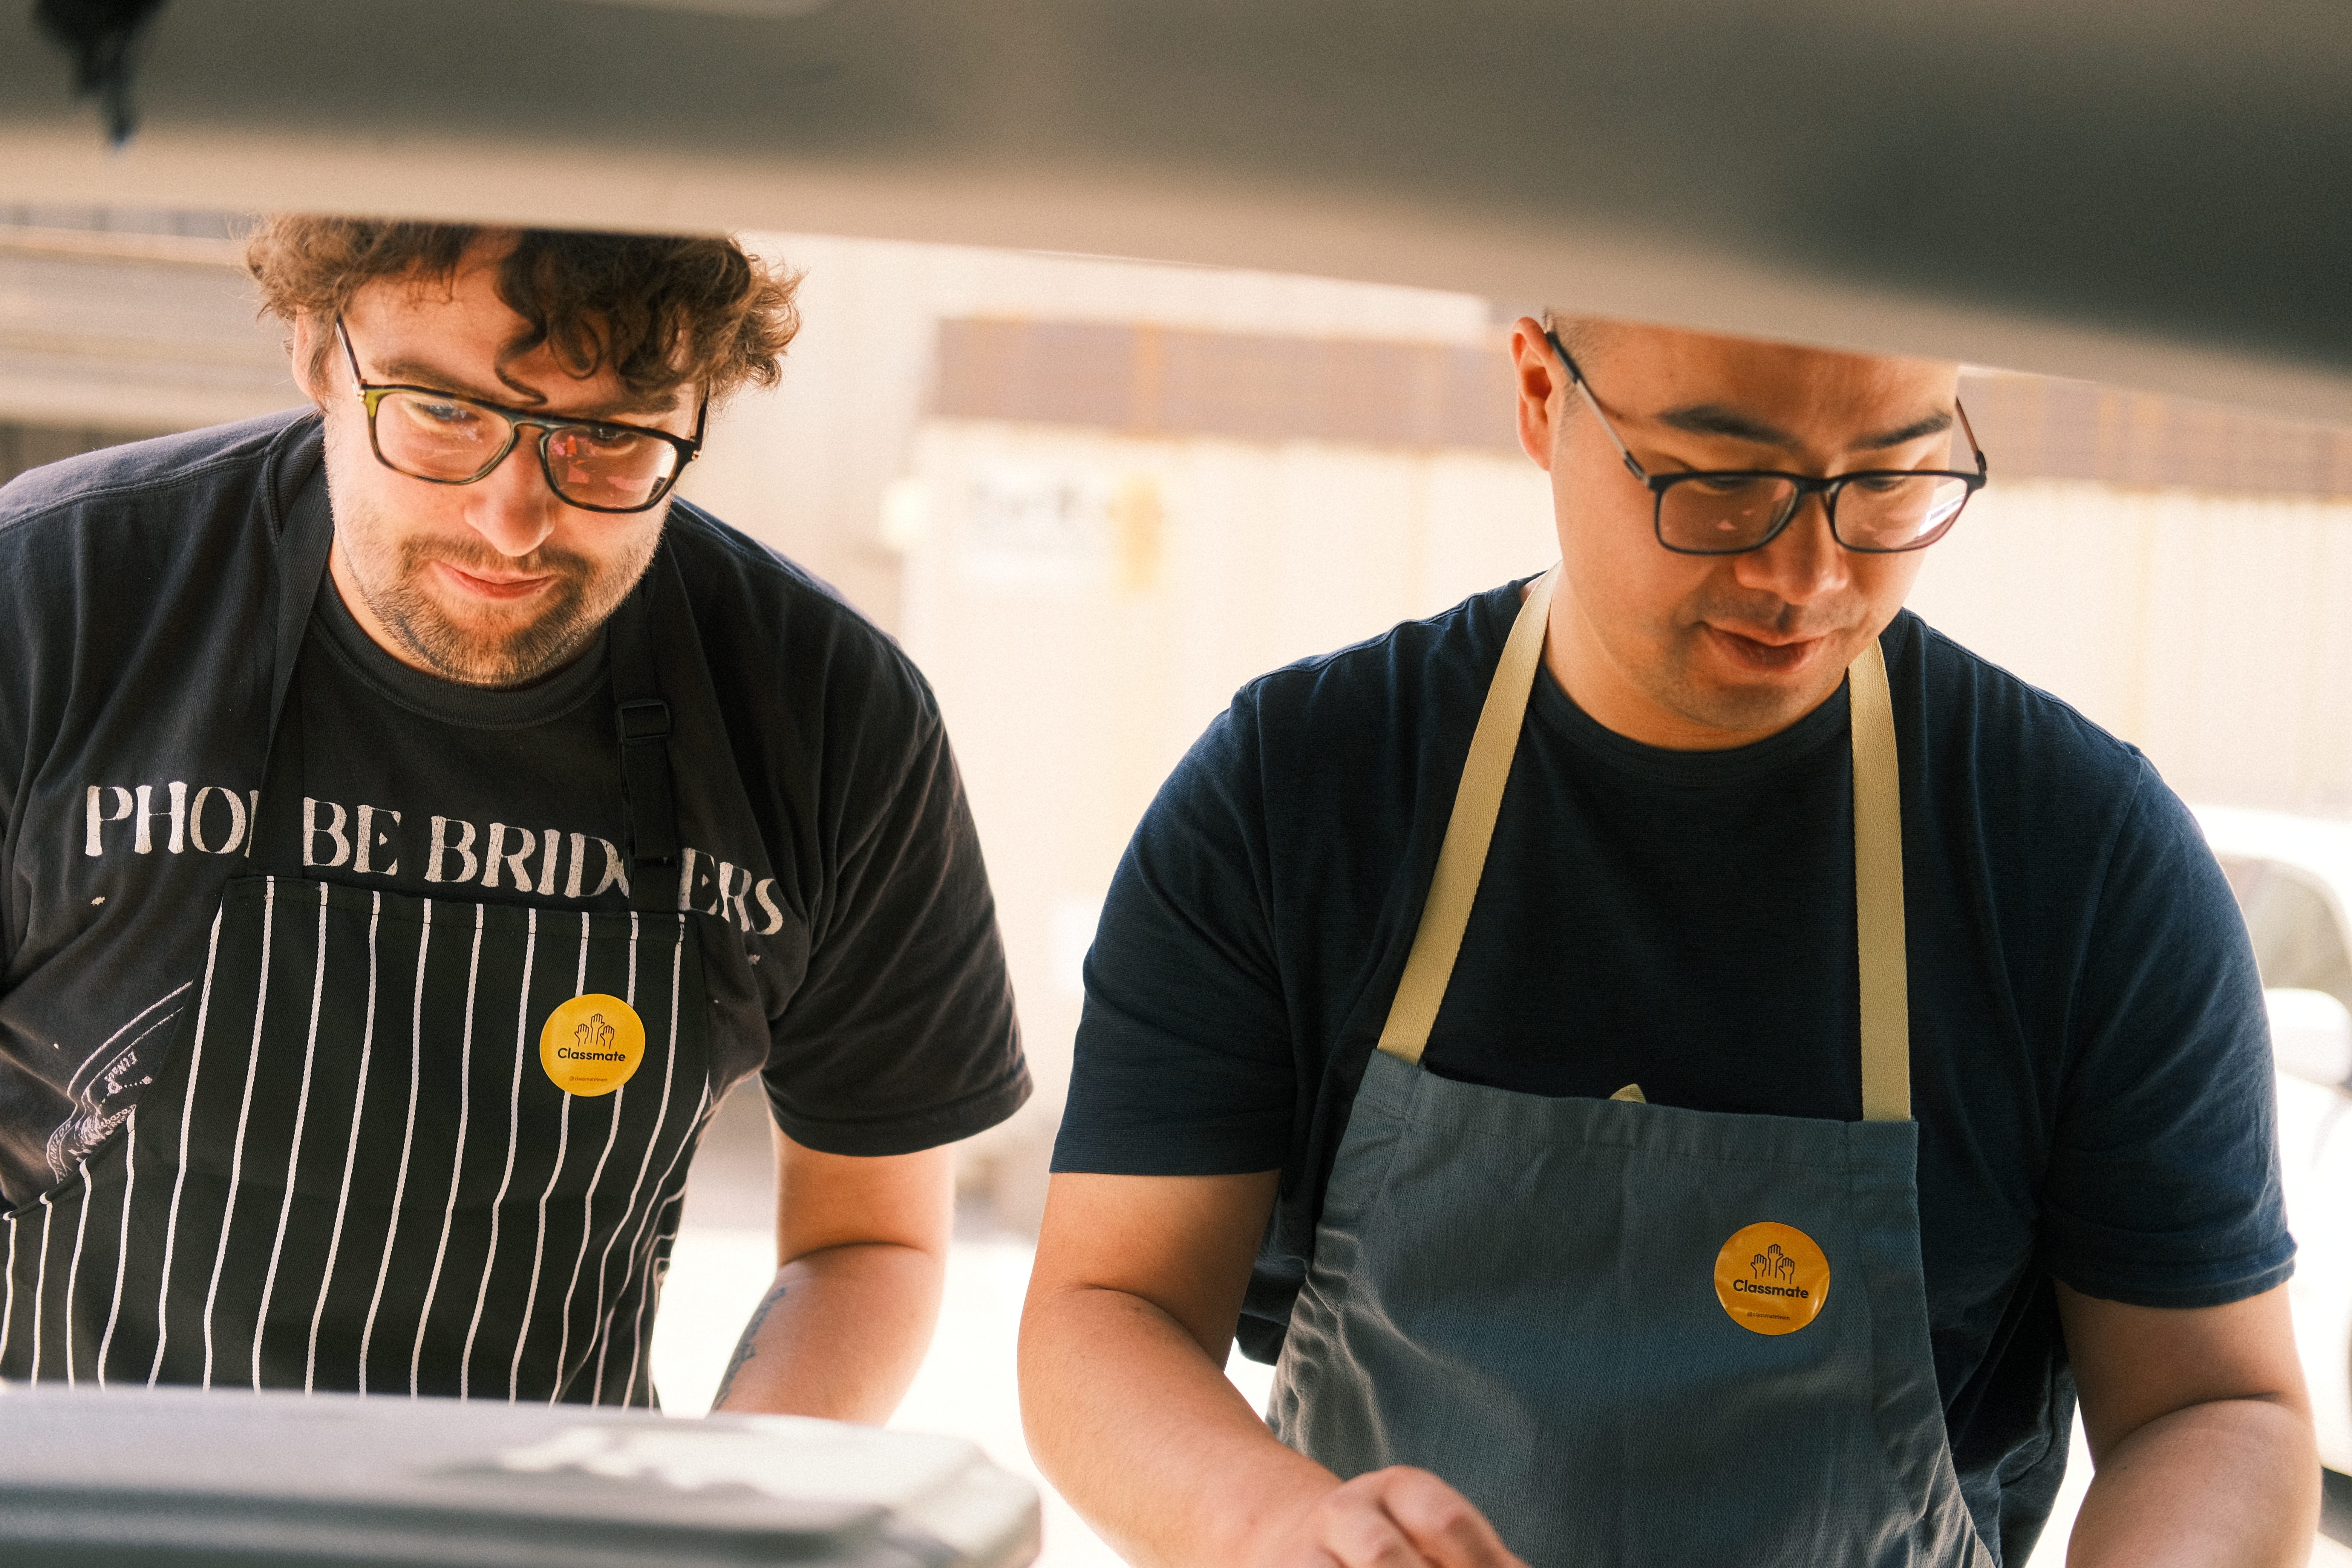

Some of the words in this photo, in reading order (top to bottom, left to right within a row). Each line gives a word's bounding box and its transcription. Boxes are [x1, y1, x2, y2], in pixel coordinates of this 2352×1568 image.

[85, 781, 401, 876] PHOBE
[557, 1047, 626, 1061] Classmate
[1733, 1279, 1809, 1298] Classmate
